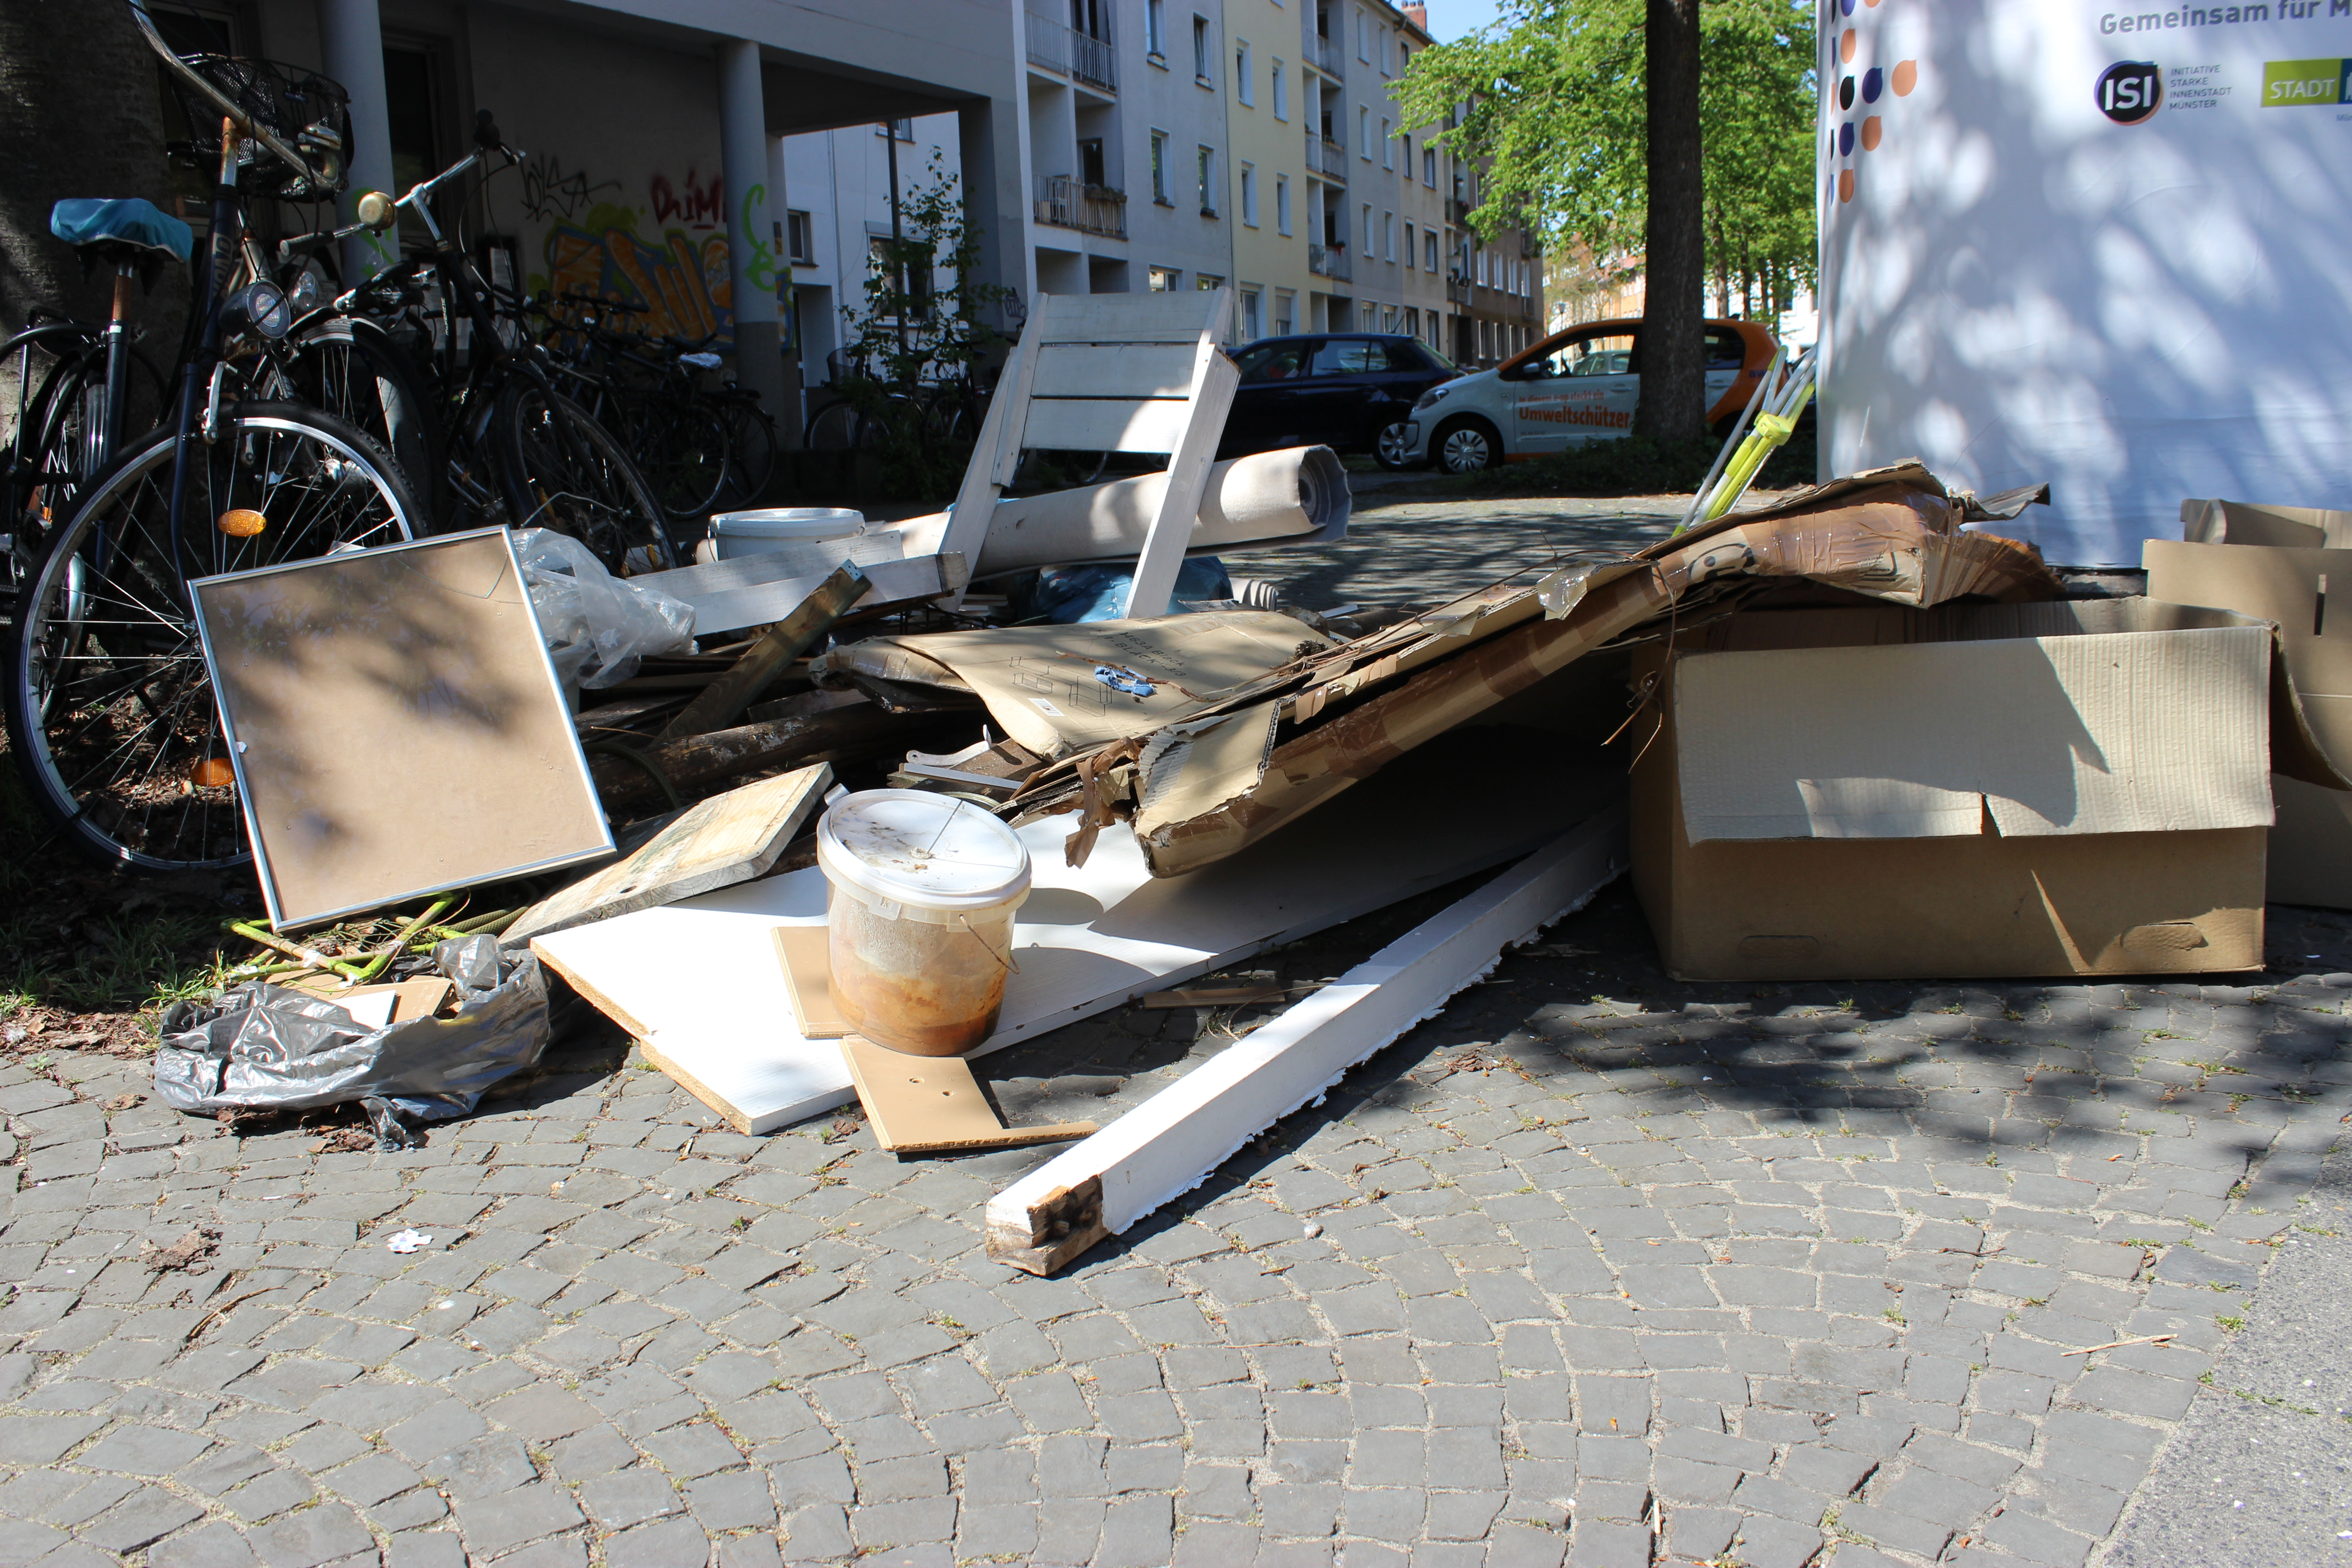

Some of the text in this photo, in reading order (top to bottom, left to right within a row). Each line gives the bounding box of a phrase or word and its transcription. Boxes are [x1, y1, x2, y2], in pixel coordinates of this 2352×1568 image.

[2100, 5, 2268, 35] Gemeinsam
[2278, 0, 2320, 20] für
[2171, 64, 2220, 76] INITIATIVE
[2170, 77, 2208, 88] STARKE
[2269, 78, 2338, 99] STADT
[2105, 75, 2153, 111] ISI
[2170, 87, 2232, 98] INNENSTADT
[2169, 99, 2217, 111] MÜNSTER
[1528, 394, 1552, 402] diesem
[1571, 390, 1592, 401] steckt
[1593, 389, 1604, 400] ein
[1519, 405, 1631, 428] Umweltschützer
[1151, 650, 1187, 667] Black
